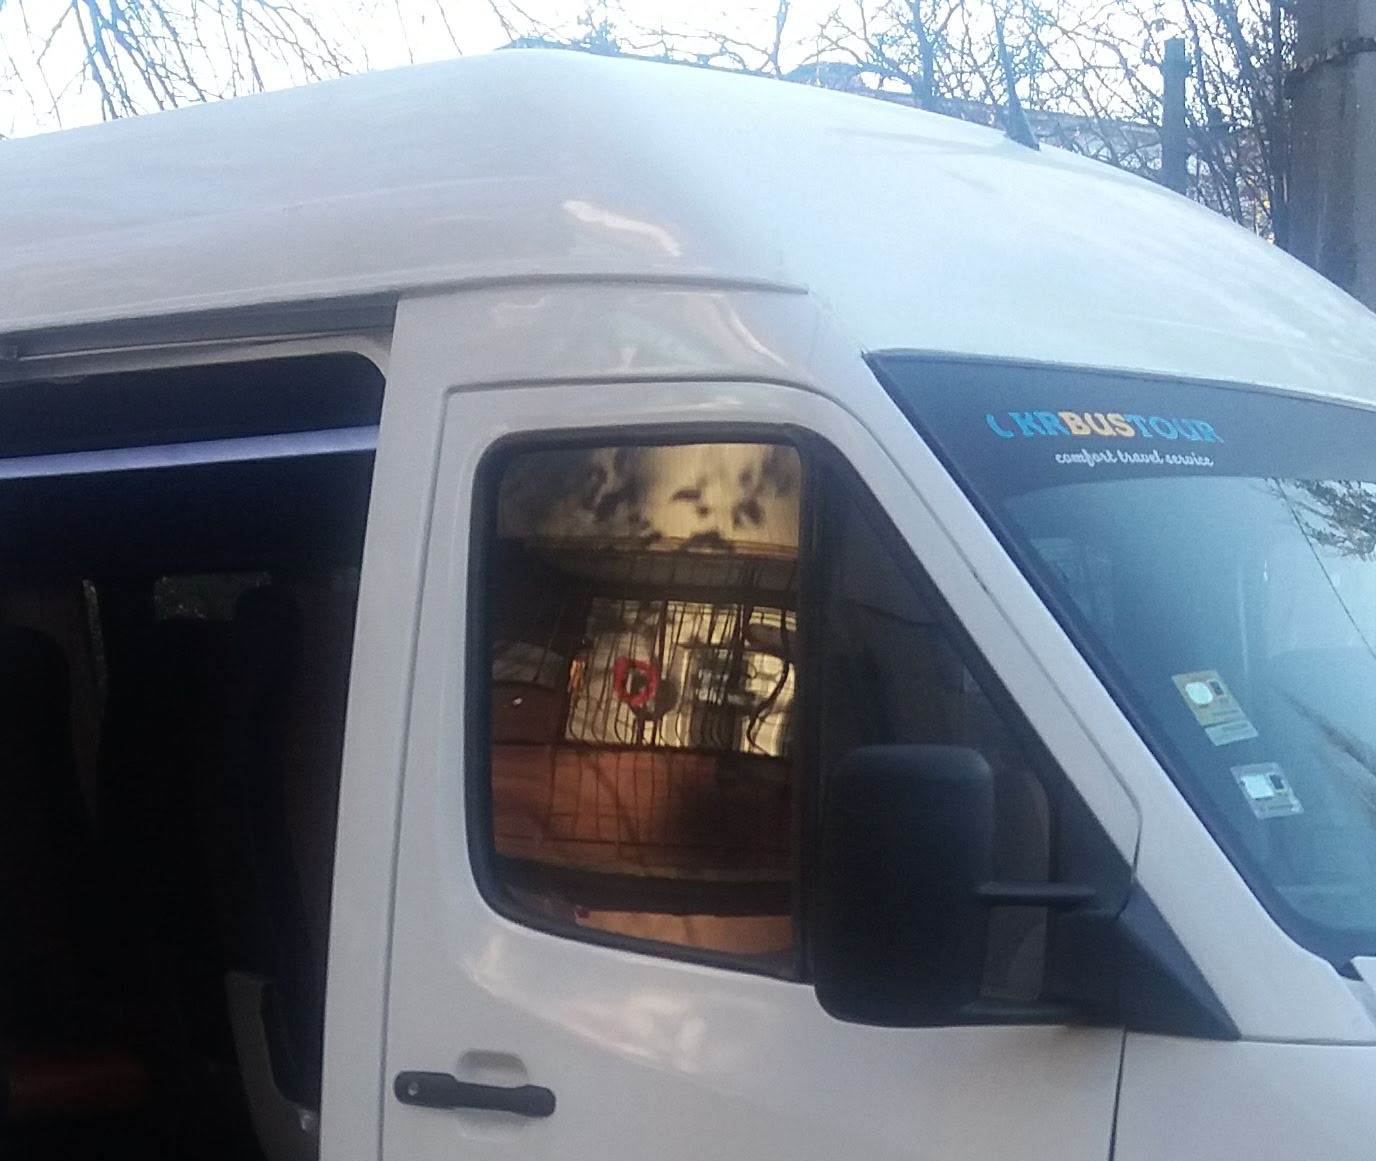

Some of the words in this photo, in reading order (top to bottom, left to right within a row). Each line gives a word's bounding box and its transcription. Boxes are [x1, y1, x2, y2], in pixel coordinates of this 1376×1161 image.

[1055, 448, 1117, 467] comfort
[1117, 449, 1163, 465] travel
[1165, 452, 1214, 467] service
